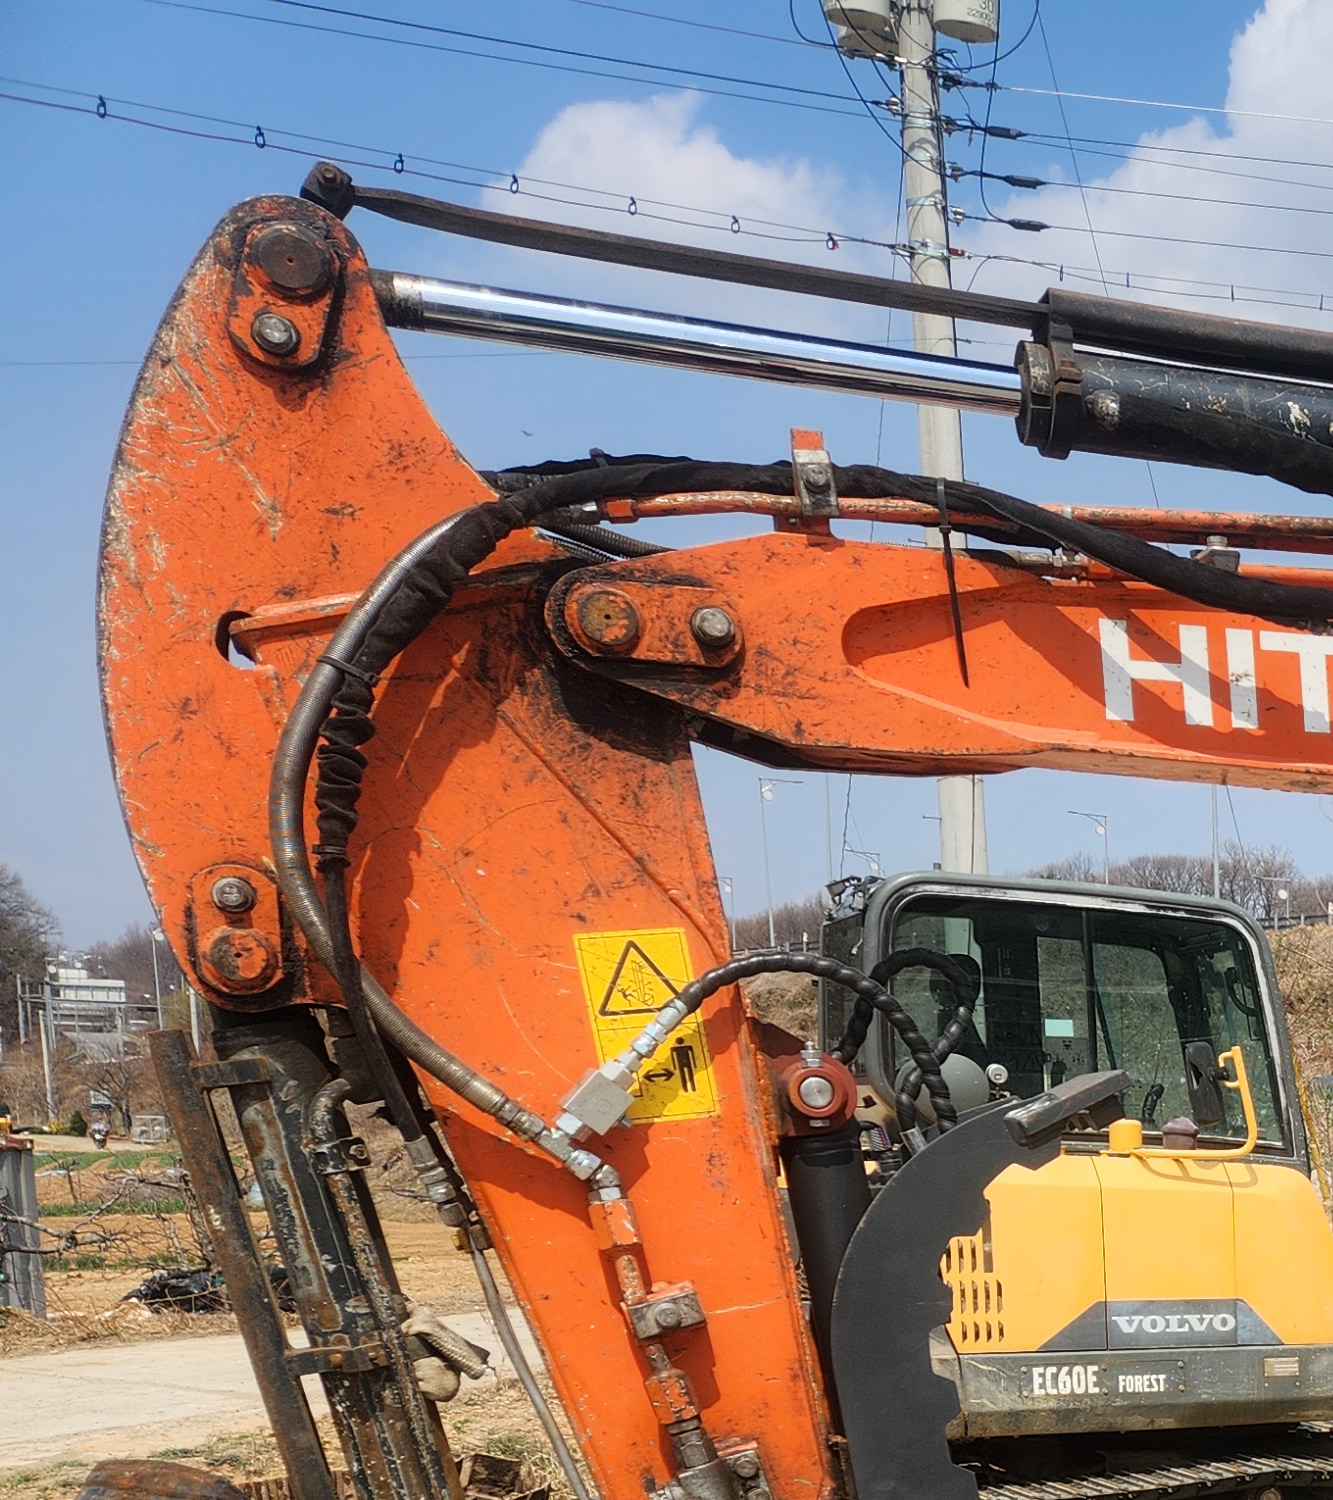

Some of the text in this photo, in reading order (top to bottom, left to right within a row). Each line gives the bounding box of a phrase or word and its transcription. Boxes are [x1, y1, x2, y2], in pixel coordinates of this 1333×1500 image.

[1112, 1313, 1236, 1334] VOLVO
[1032, 1365, 1167, 1396] EC60E FOREST
